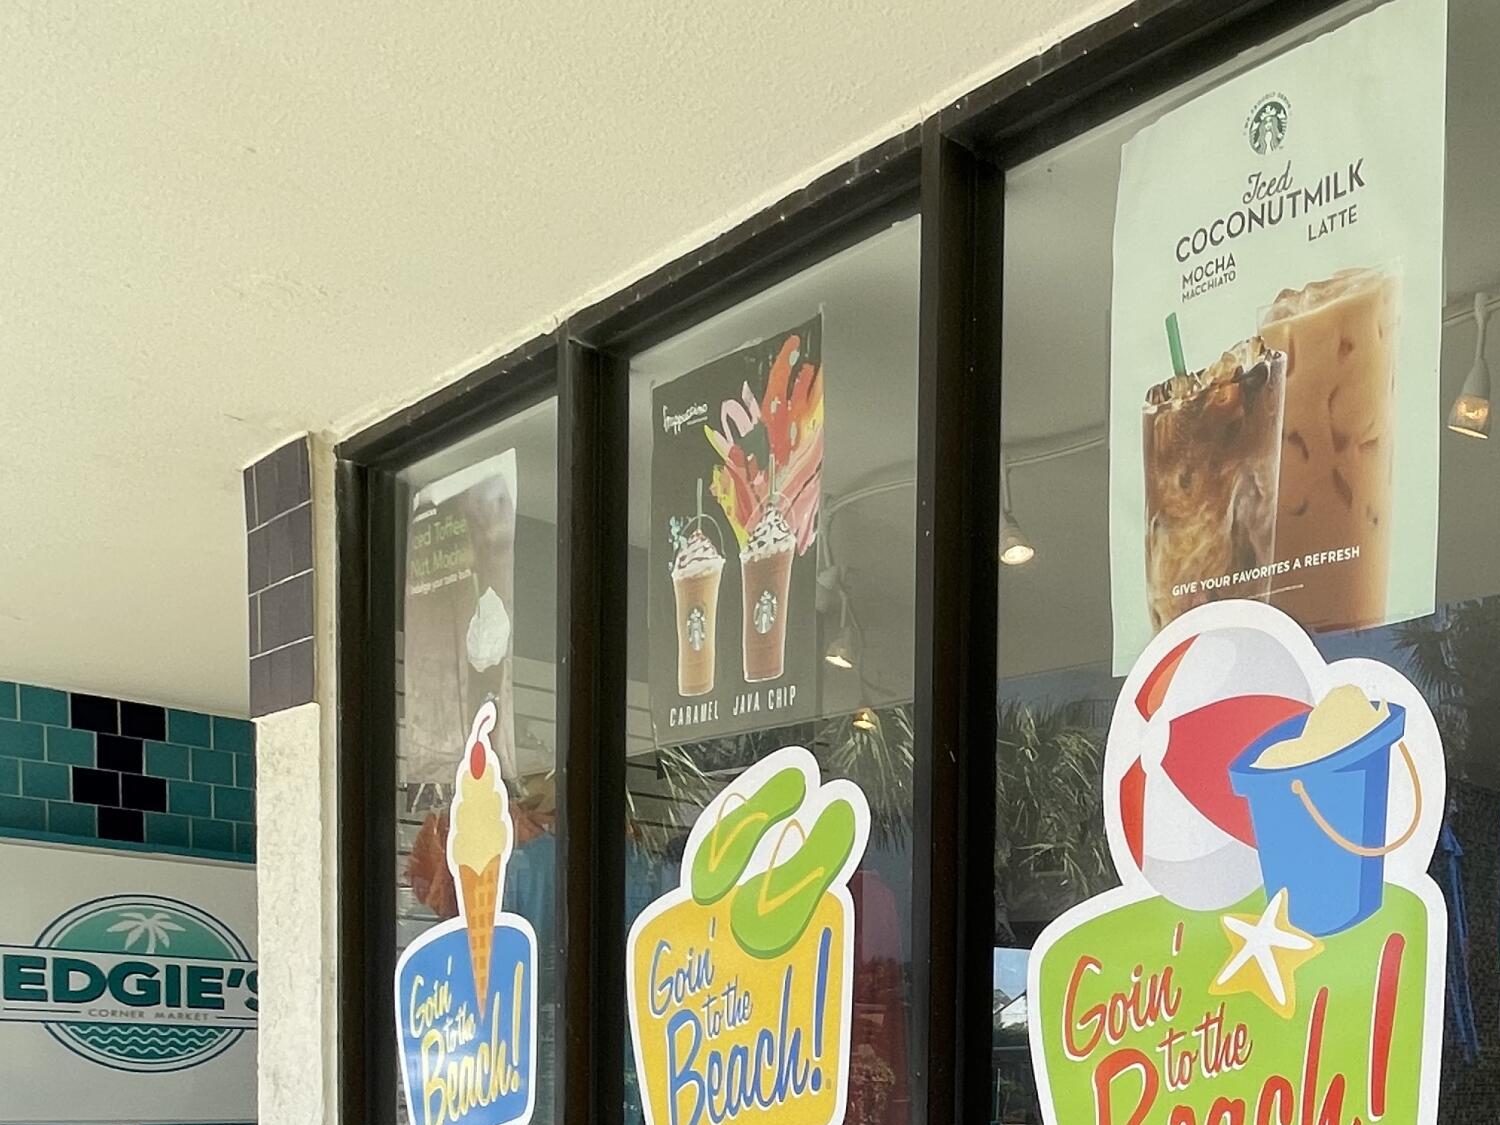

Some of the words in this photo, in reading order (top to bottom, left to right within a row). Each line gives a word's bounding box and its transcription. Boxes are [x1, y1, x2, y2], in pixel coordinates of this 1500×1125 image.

[1242, 160, 1294, 205] Iced
[1175, 158, 1366, 263] COCONUTMILK
[1308, 204, 1357, 242] LATTE
[1182, 252, 1236, 290] MOCHA
[1182, 270, 1236, 303] MACCHIATO
[1171, 582, 1198, 597] GIVE
[1200, 575, 1231, 591] YOUR
[1232, 560, 1290, 585] FAVORITES
[1292, 557, 1302, 571] A
[1304, 545, 1360, 567] REFRESH
[669, 700, 719, 727] CARAMEL
[732, 691, 761, 716] JAVA
[768, 685, 797, 710] CHIP
[650, 916, 716, 1018] Goin'
[1062, 921, 1185, 1061] Goin'
[88, 1006, 145, 1019] CORNER
[154, 1010, 209, 1022] MARKET
[409, 954, 453, 1039] Goin'
[702, 994, 724, 1039] to
[721, 975, 753, 1031] the
[1156, 1027, 1197, 1092] to
[1192, 1002, 1254, 1081] the
